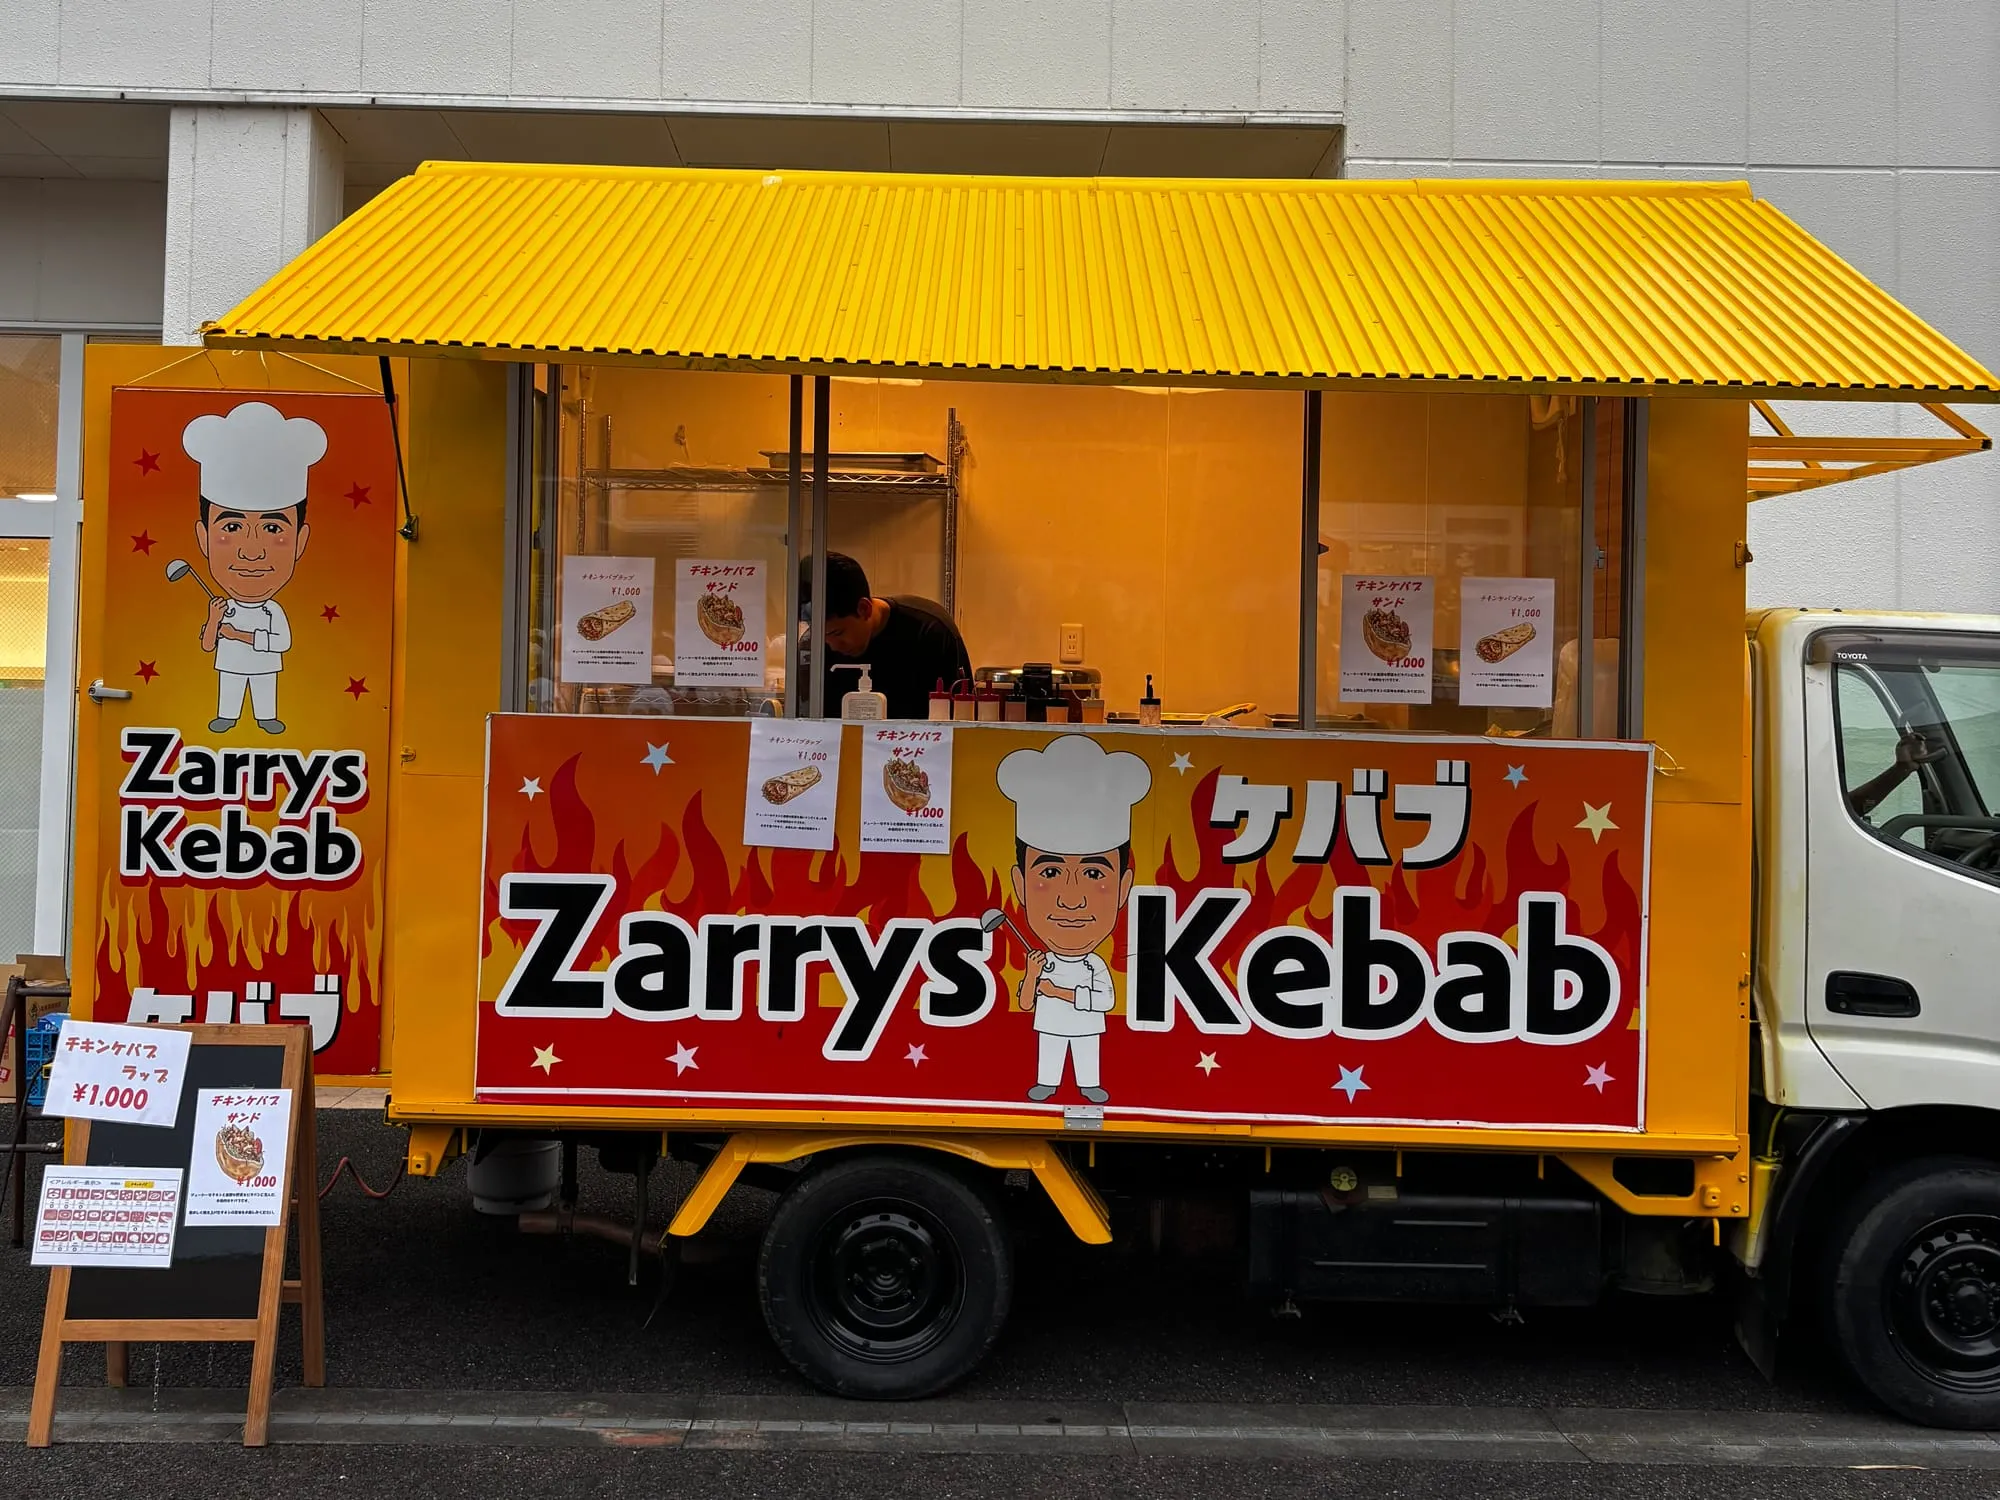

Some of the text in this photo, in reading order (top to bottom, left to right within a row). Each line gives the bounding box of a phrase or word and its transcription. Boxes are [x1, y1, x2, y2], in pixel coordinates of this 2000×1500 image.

[690, 565, 756, 577] チキンケバブ
[706, 582, 739, 592] サンド
[1355, 580, 1423, 592] チキンケバブ
[1372, 598, 1405, 608] サンド
[1837, 652, 1868, 660] TOYOTA
[876, 730, 943, 742] チキンケバブ
[892, 747, 925, 758] サンド
[121, 728, 366, 818] Zarrys
[1210, 760, 1472, 869] ケバブ
[121, 805, 361, 881] Kebab
[498, 874, 1619, 1060] Zarrys Kebab
[65, 1037, 159, 1059] チキンケバブ
[122, 1065, 169, 1083] ラップ
[73, 1083, 149, 1110] ¥1,000
[212, 1095, 280, 1106] チキンケバブ
[227, 1112, 261, 1123] サンド
